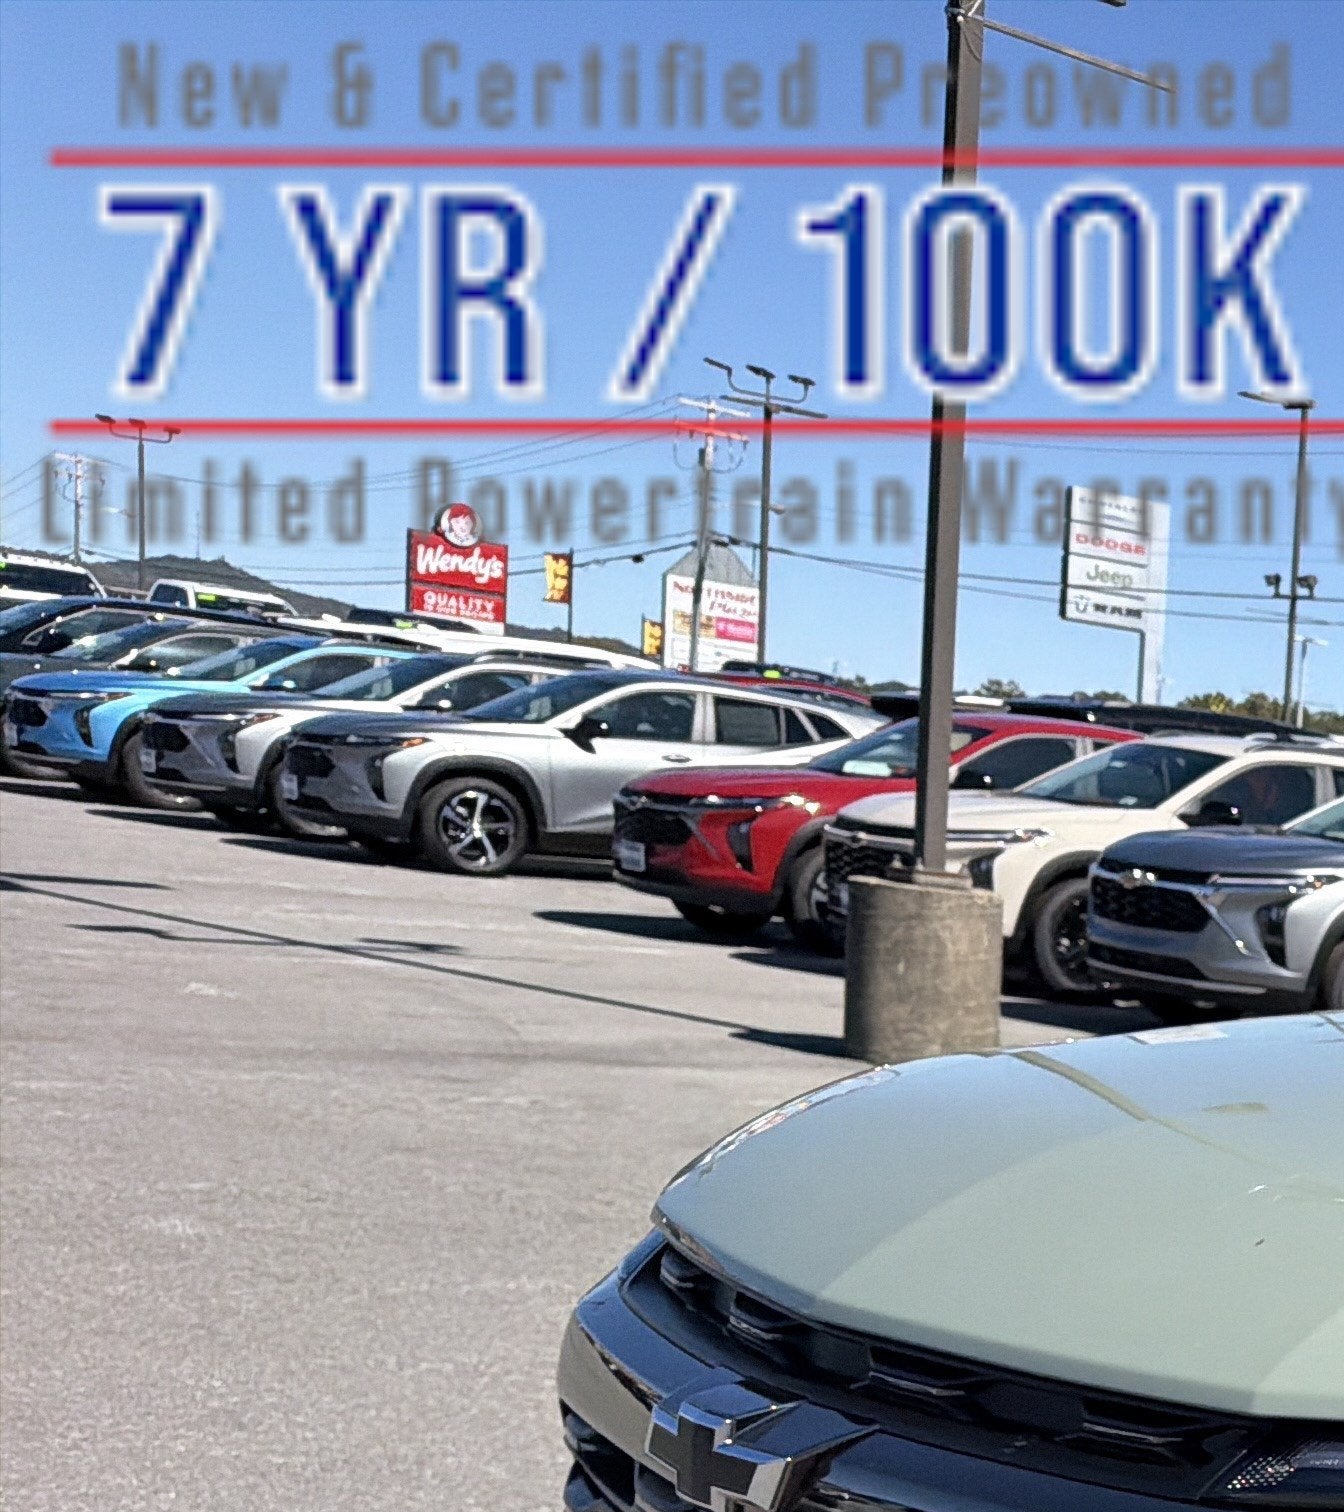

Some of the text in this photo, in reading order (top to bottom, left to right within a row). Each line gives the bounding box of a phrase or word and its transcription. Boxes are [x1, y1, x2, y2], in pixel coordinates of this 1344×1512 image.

[416, 543, 505, 584] Wendy's
[1086, 564, 1133, 588] Jeep
[423, 590, 495, 612] QUALITY
